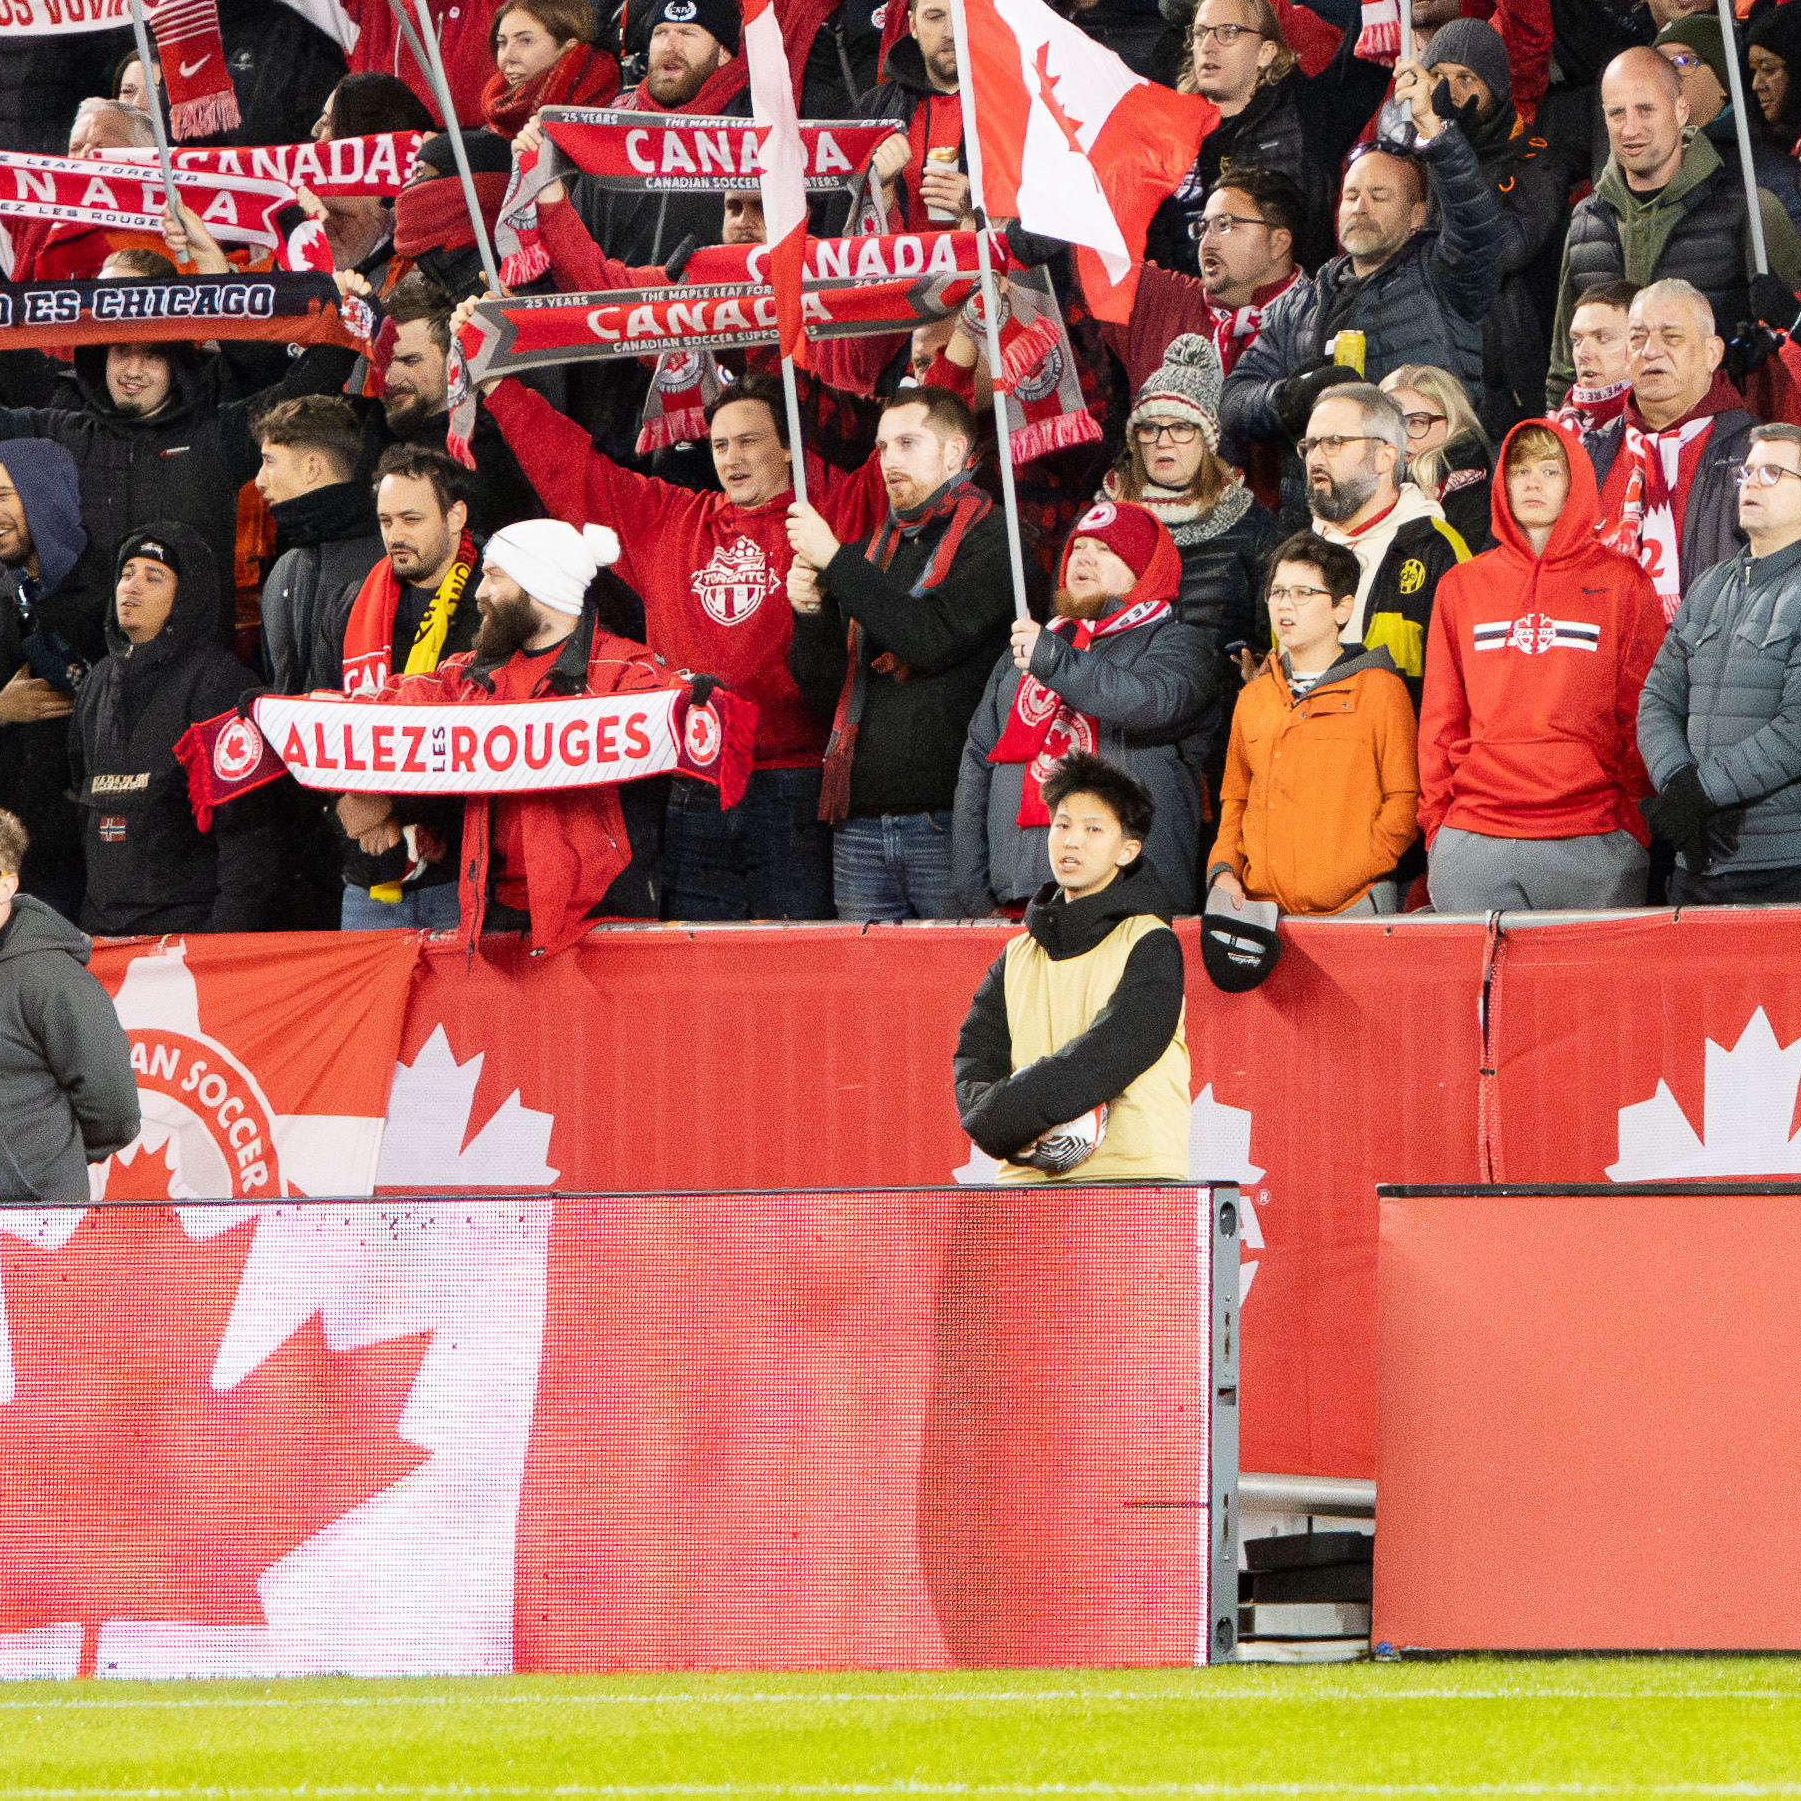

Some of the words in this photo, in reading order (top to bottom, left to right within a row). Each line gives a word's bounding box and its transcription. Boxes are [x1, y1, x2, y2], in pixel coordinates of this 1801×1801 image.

[579, 111, 619, 125] YEARS
[27, 157, 81, 172] LEAF
[97, 165, 199, 183] FOREVER
[644, 175, 710, 190] CANADIAN
[712, 175, 760, 190] SOCCER
[39, 206, 78, 218] LES
[91, 211, 161, 227] ROUGE
[746, 233, 959, 279] CNADA
[22, 288, 82, 330] ES
[90, 283, 277, 323] CHICAGO
[524, 297, 541, 309] 25
[544, 295, 589, 308] YEARS
[640, 289, 665, 301] THE
[667, 287, 711, 300] MAPLE
[712, 285, 744, 297] LEAF
[586, 292, 831, 340] CANADA
[612, 336, 681, 355] CANADIAN
[682, 331, 734, 348] SOCCER
[283, 722, 428, 776] ALLEZ
[431, 726, 448, 773] LES
[452, 712, 652, 773] ROUGES
[184, 1058, 271, 1189] SOCCER
